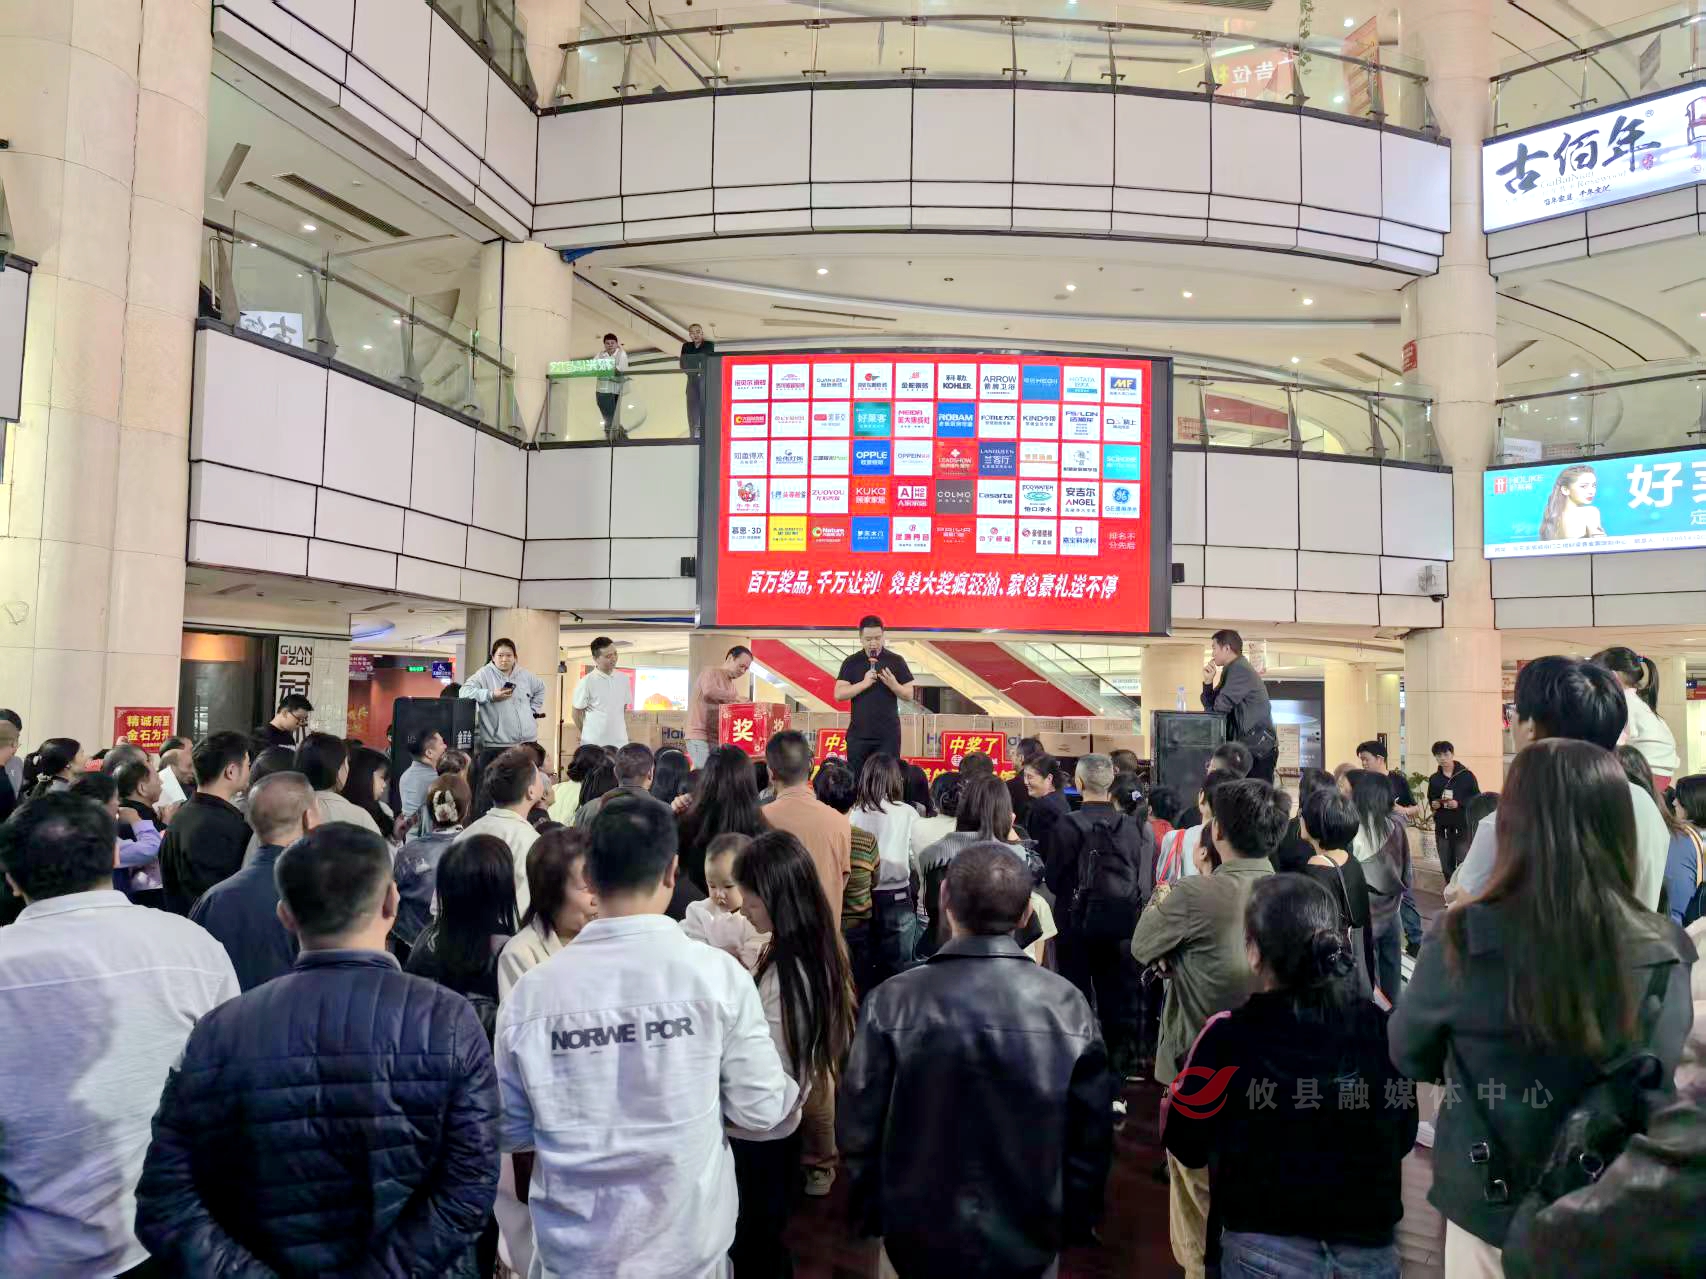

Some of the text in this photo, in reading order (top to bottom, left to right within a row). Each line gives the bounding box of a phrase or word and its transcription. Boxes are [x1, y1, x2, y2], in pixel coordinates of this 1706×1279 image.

[1496, 115, 1662, 194] 古佰年
[983, 375, 1017, 384] ARROW
[942, 382, 972, 390] KOHLER
[938, 413, 974, 421] ROBAM
[856, 451, 888, 459] OPPLE
[1626, 462, 1706, 510] 好
[937, 491, 971, 499] COLMO
[1065, 487, 1096, 498] 安吉尔
[1065, 498, 1096, 507] ANGEL
[279, 644, 313, 656] GUAN
[287, 655, 313, 667] ZHU
[661, 726, 687, 739] Hai
[732, 718, 754, 743] 奖
[949, 736, 999, 755] 中奖了
[551, 1016, 695, 1050] NORWE POR
